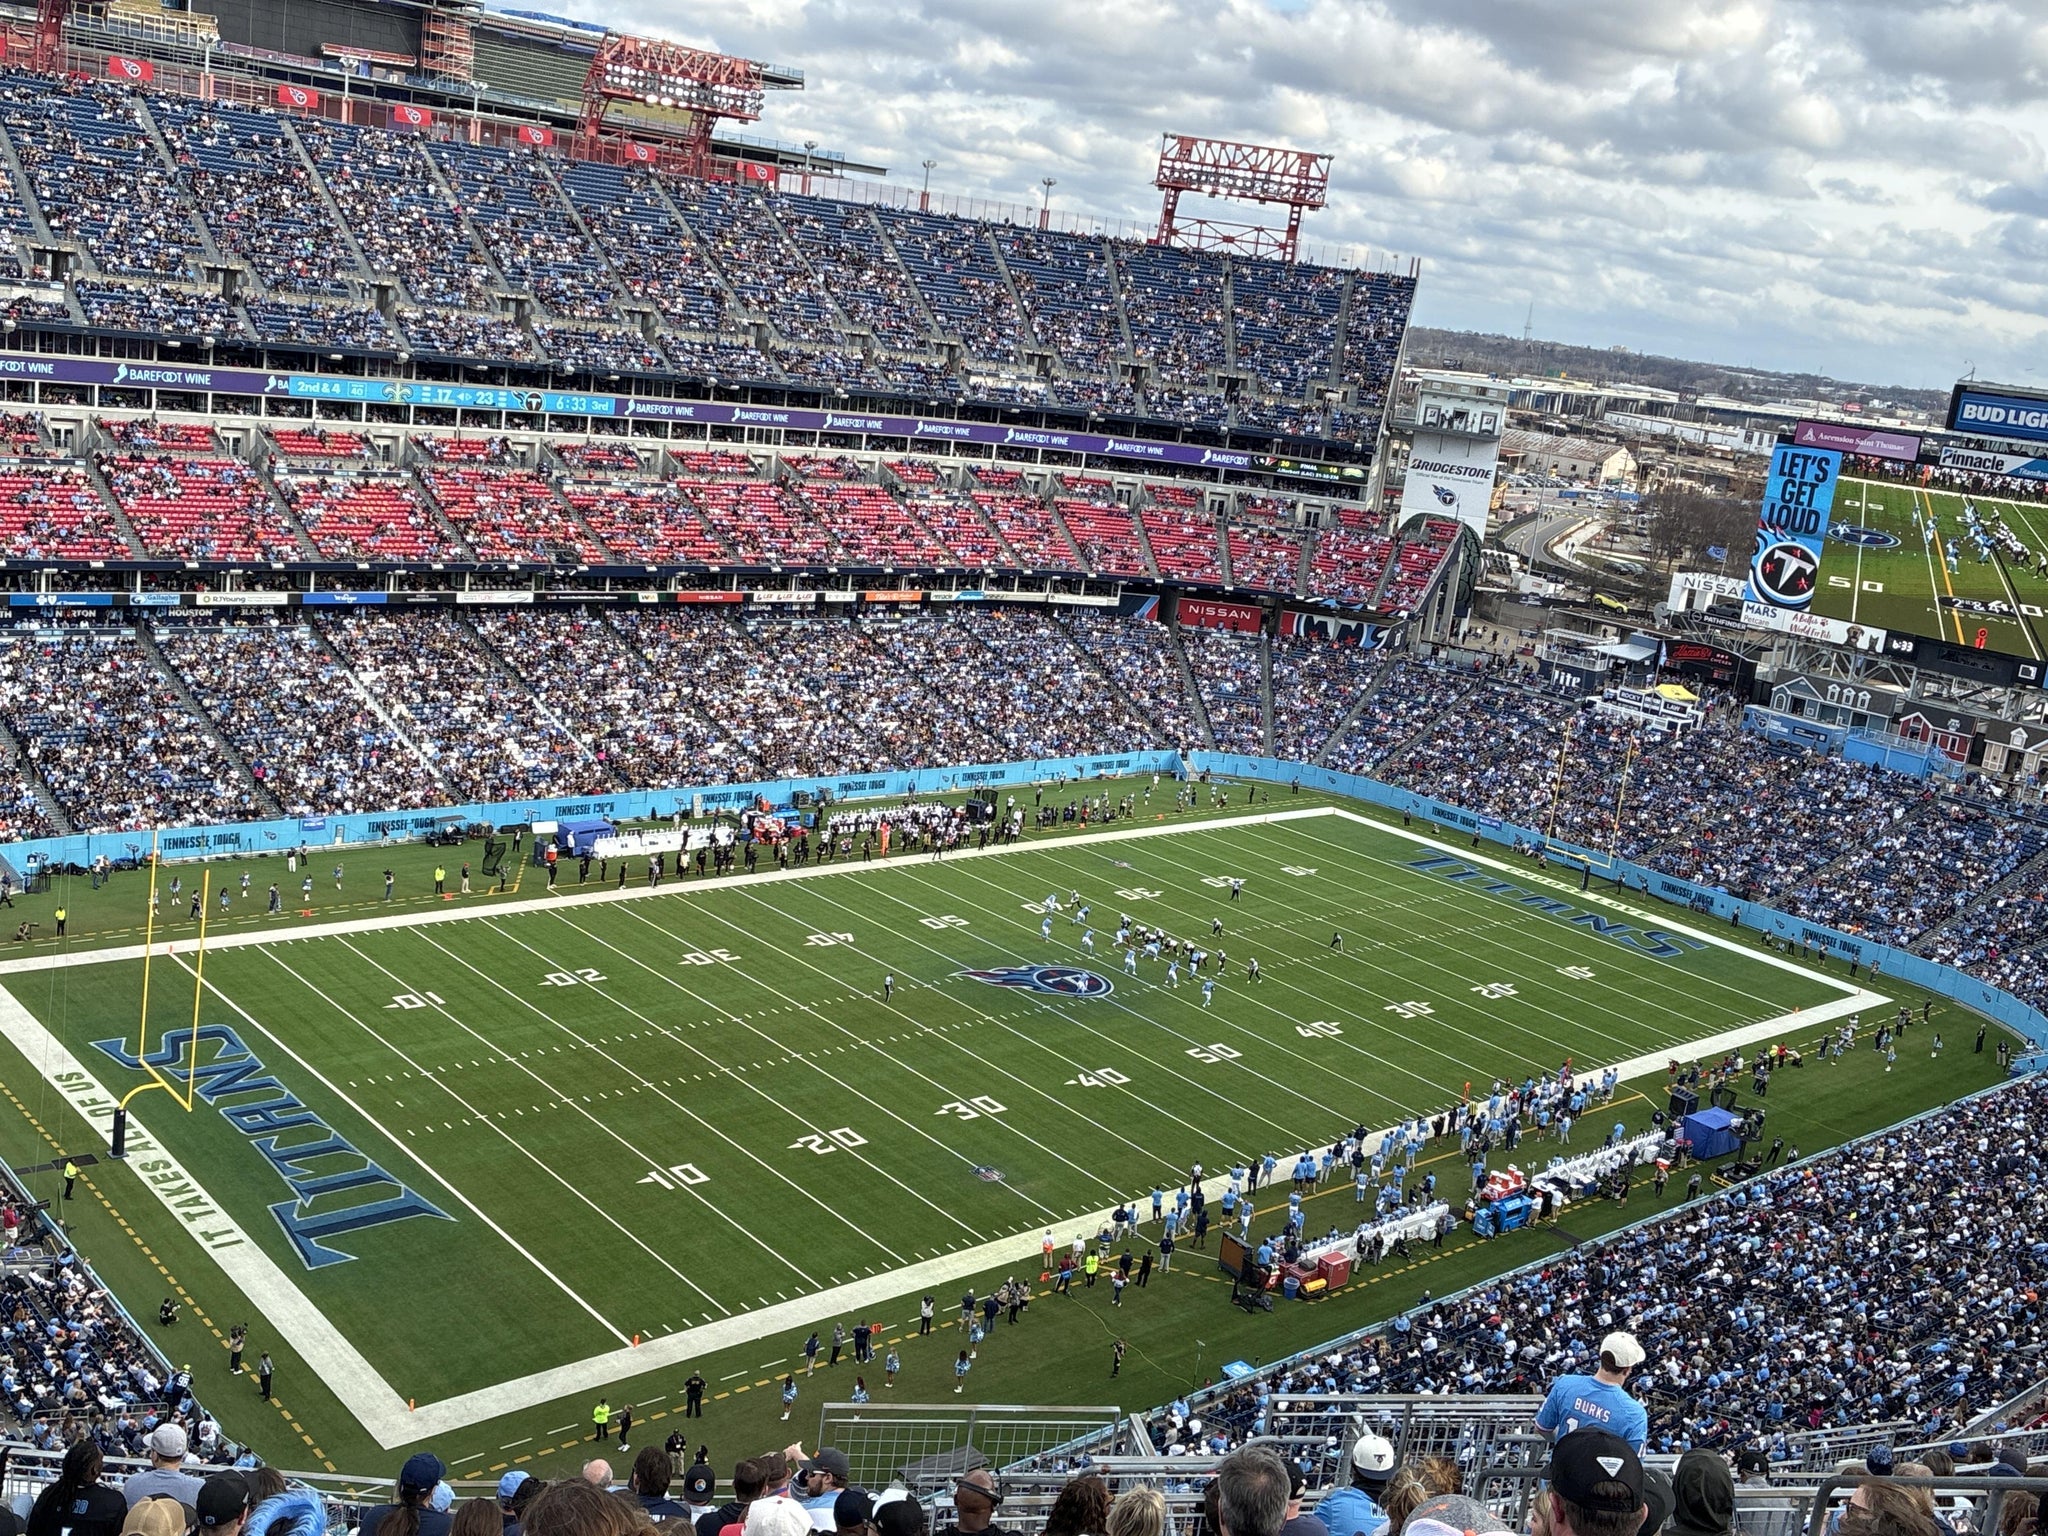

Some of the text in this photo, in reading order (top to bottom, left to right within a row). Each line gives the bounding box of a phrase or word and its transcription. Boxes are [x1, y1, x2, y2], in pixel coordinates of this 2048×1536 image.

[28, 362, 54, 375] WINE
[129, 369, 211, 386] BAREFOOT WINE
[297, 381, 341, 394] 2nd & 4
[351, 387, 364, 397] 40
[437, 389, 452, 400] 17
[475, 392, 494, 405] 23
[556, 396, 609, 412] 6:33 3rd
[636, 403, 694, 417] BAREFOOT WINE
[741, 411, 788, 423] BAREFOOT WINE
[1963, 404, 2005, 424] BUD
[833, 417, 883, 430] BAREFOOT WINE
[923, 424, 970, 437] BAREFOOT WINE
[1014, 431, 1069, 446] BAREFOOT WINE
[1818, 432, 1905, 452] Ascension Saint Thomas
[1114, 442, 1164, 456] BAREFOOT WINE
[1212, 453, 1249, 466] BAREFOOT
[1778, 451, 1831, 483] LET'S
[1942, 450, 2005, 471] Pinnacle
[1410, 458, 1493, 480] BRIDGESTONE
[1781, 479, 1819, 507] GET
[1767, 503, 1820, 535] LOUD
[1828, 575, 1884, 593] 50
[147, 594, 179, 603] Gallagher
[55, 609, 97, 618] NRTON
[168, 608, 213, 618] HOUSTON
[1188, 604, 1251, 620] NISSAN
[1745, 603, 1778, 619] MARS
[1703, 615, 1747, 631] PATHFINDER
[1743, 615, 1770, 627] Petcare
[163, 835, 210, 850] TENNESSEE
[1403, 848, 1710, 959] TITANS
[919, 915, 970, 929] 50
[808, 932, 855, 946] 40
[682, 949, 741, 966] 30
[545, 968, 608, 986] 20
[1470, 983, 1516, 999] 20
[392, 991, 447, 1010] 10
[1384, 1001, 1430, 1019] 30
[1295, 1020, 1340, 1040] 40
[1184, 1042, 1243, 1064] 50
[54, 1071, 95, 1093] US
[1077, 1067, 1132, 1088] 40
[76, 1097, 116, 1118] OF
[943, 1095, 1008, 1121] 30
[88, 1023, 461, 1271] TITANS
[796, 1127, 869, 1155] 20
[648, 1163, 711, 1190] 10
[138, 1158, 221, 1224] TAKES
[198, 1227, 246, 1250] IT
[1573, 1396, 1612, 1424] BURKS
